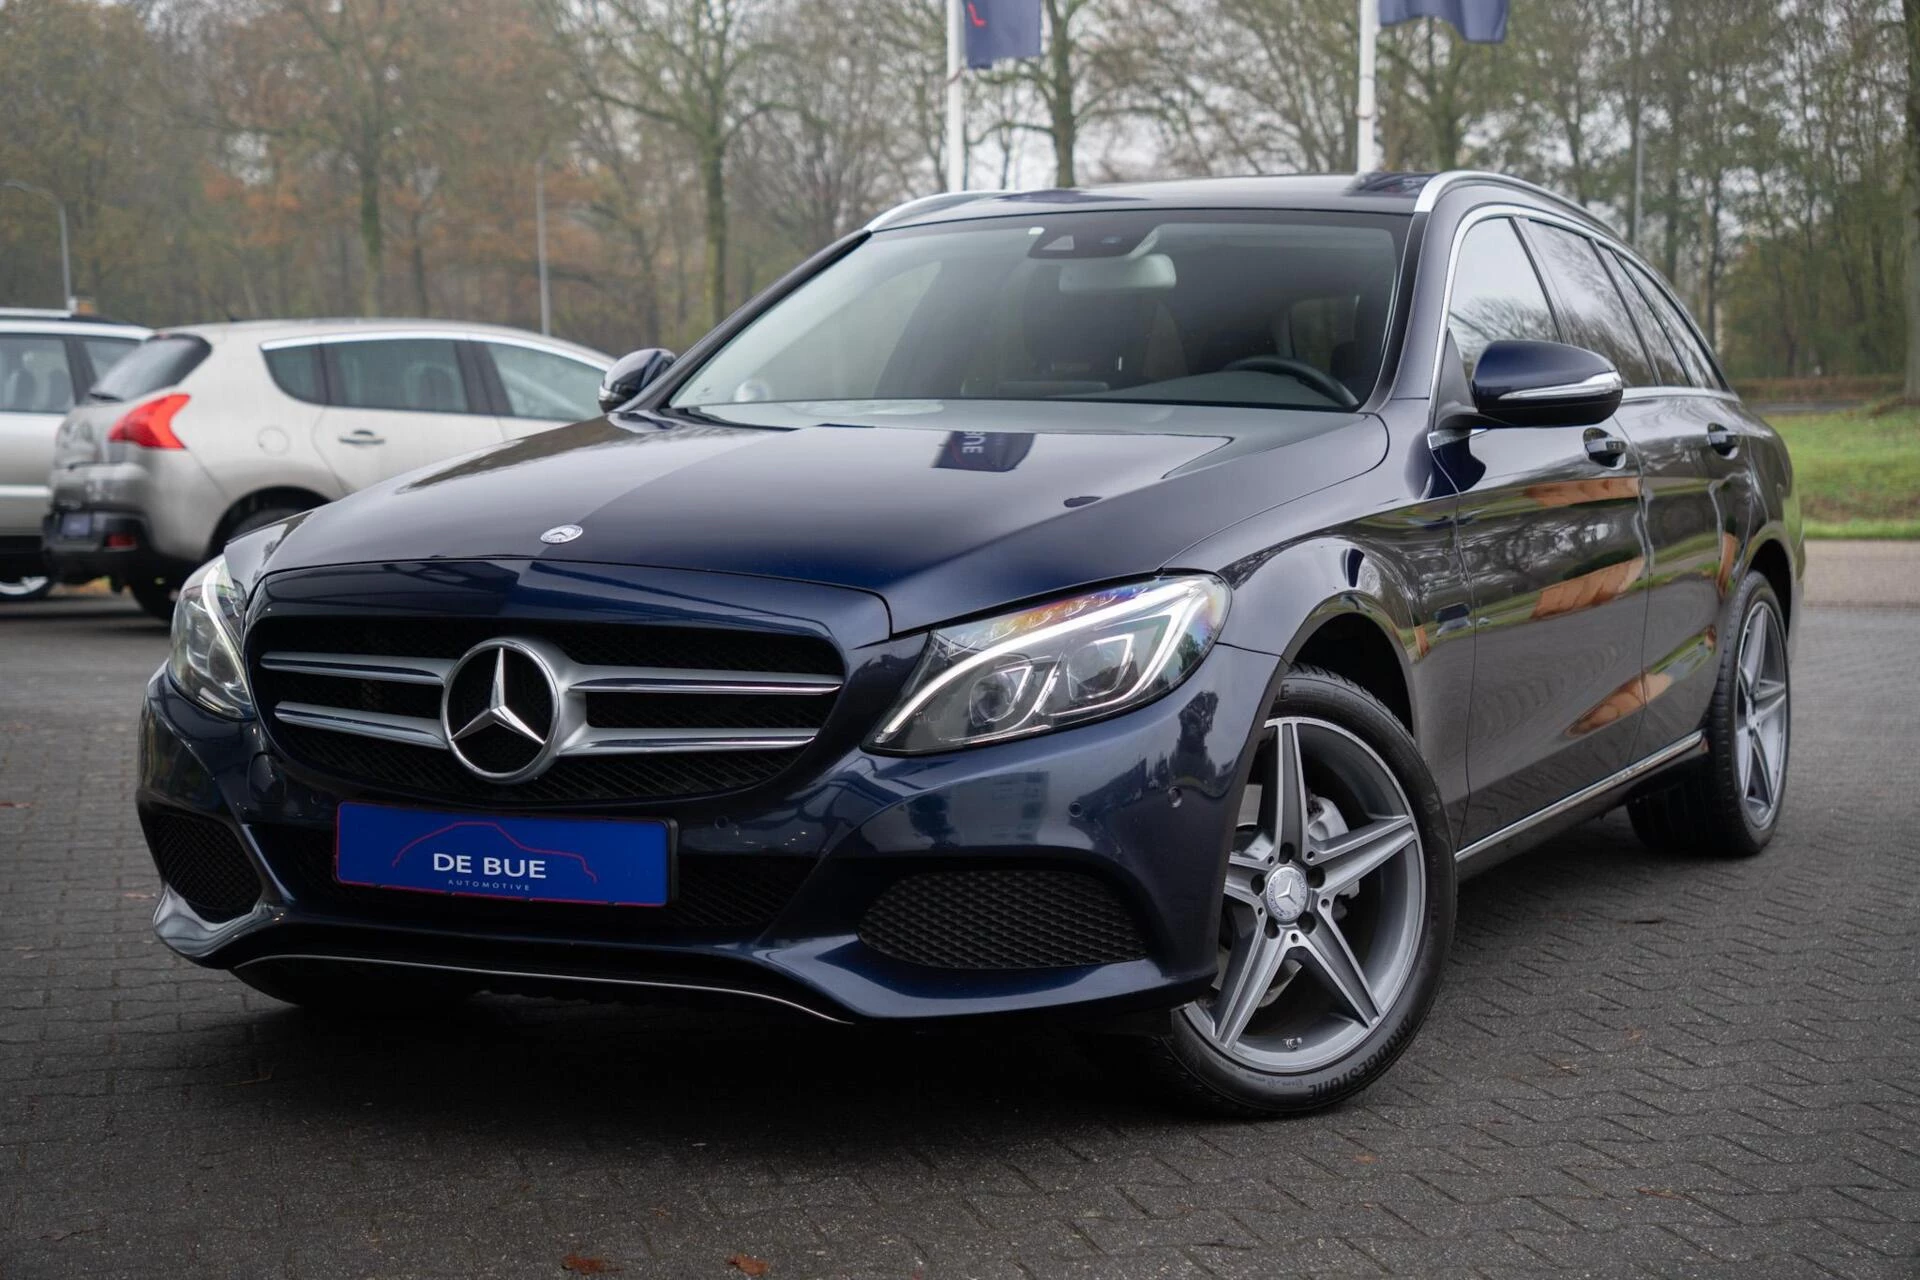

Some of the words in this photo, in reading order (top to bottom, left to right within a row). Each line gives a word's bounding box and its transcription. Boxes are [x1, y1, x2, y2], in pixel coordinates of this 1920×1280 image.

[433, 853, 472, 873] DE
[483, 857, 547, 878] BUE
[448, 879, 530, 891] AUTOMOTIVE
[1308, 1015, 1411, 1097] BRIDGESTONE
